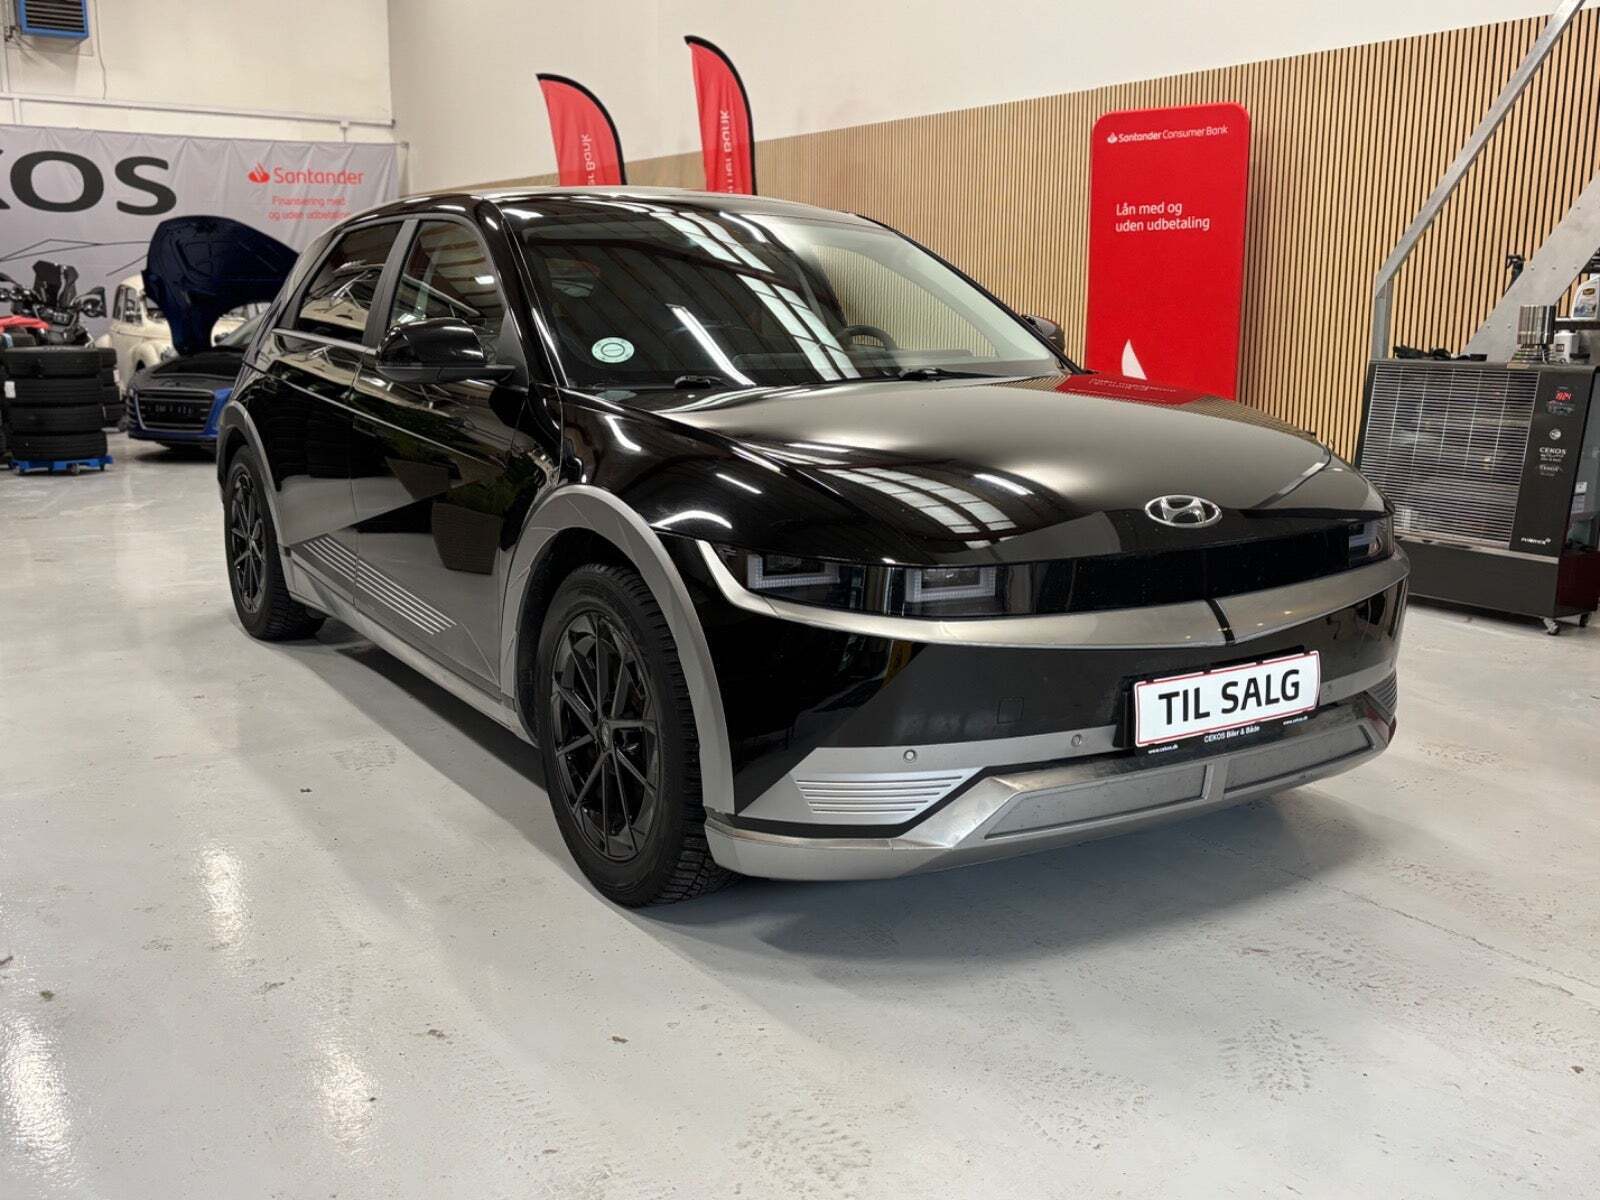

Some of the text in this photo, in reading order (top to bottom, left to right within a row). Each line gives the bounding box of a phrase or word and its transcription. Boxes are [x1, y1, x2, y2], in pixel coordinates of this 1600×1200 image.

[1118, 124, 1228, 143] Santander Consumer Bank
[580, 134, 596, 171] Bank
[0, 148, 177, 216] OS
[273, 166, 363, 185] Santander
[1116, 201, 1182, 216] Lån med og
[1115, 216, 1211, 232] uden udbetaling
[1158, 669, 1300, 725] TIL SALG
[1204, 731, 1226, 743] CEKOS
[1226, 729, 1240, 739] Biler
